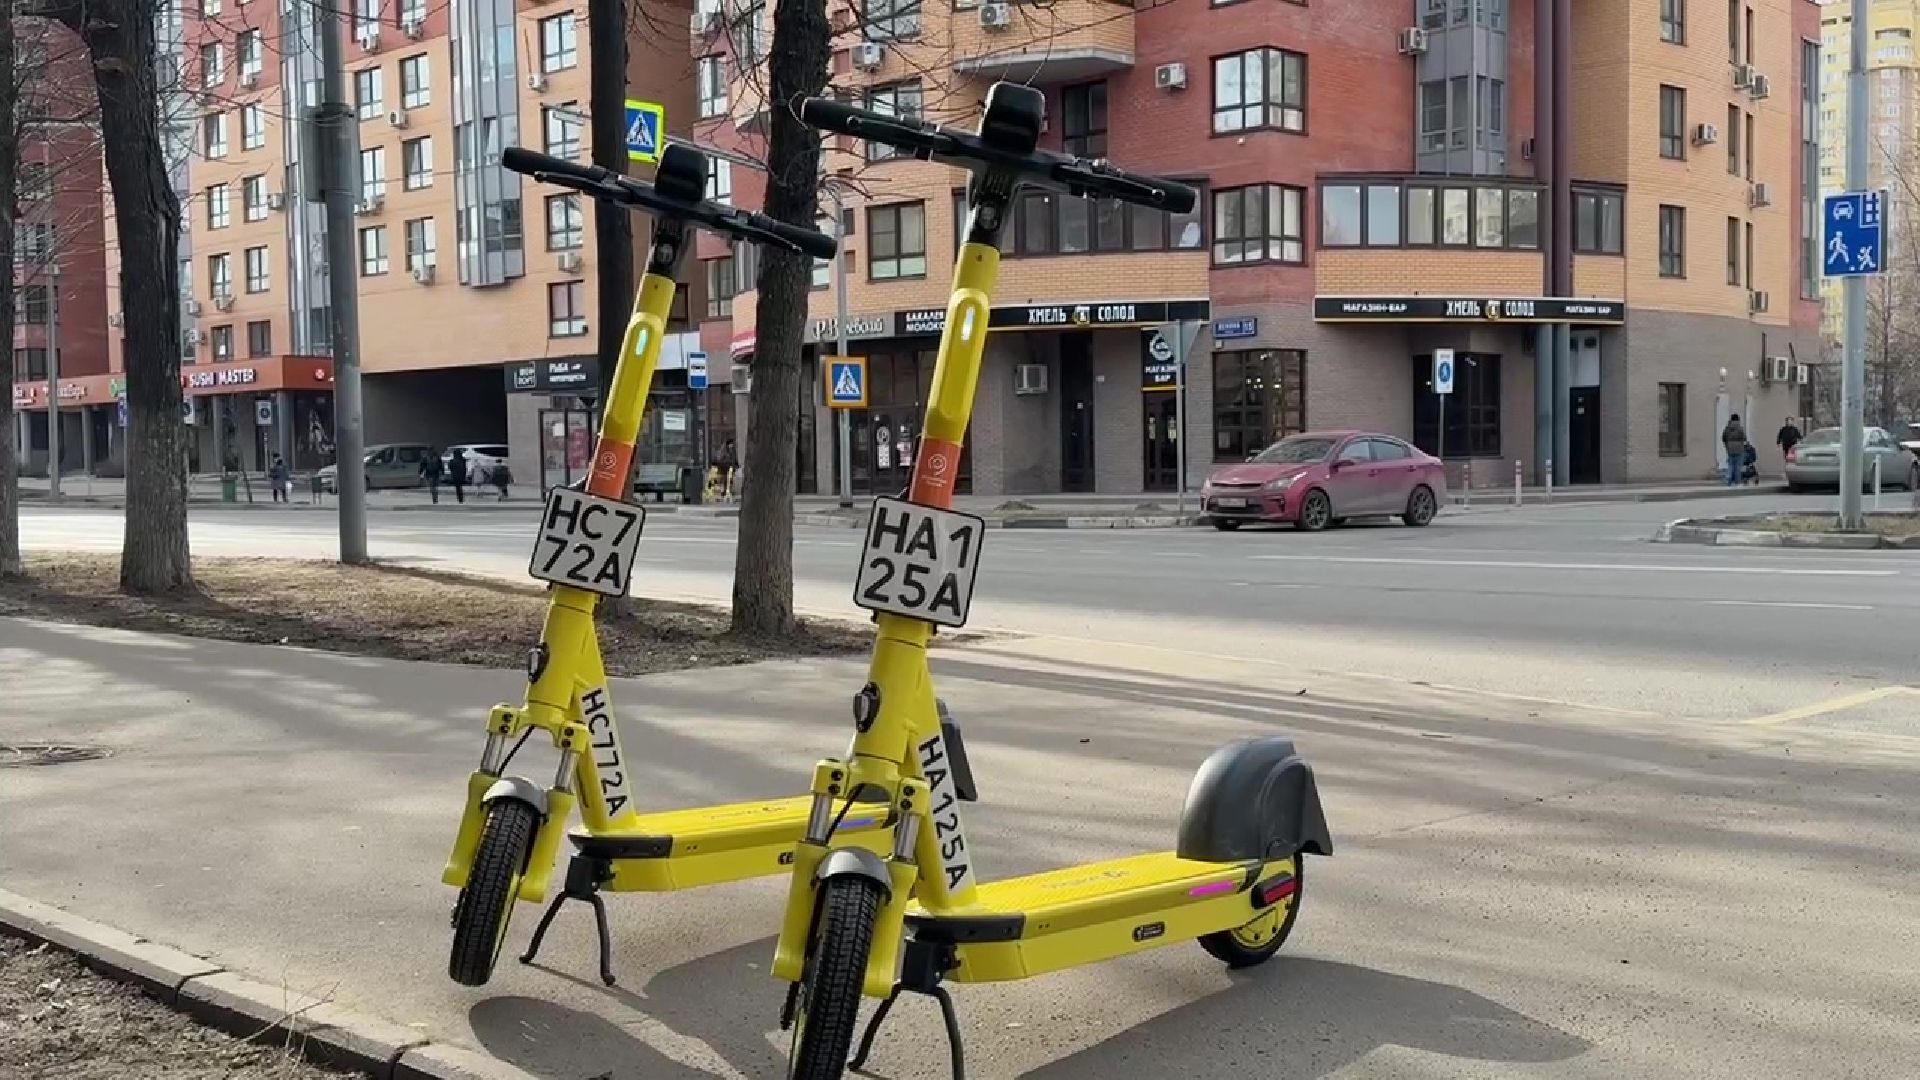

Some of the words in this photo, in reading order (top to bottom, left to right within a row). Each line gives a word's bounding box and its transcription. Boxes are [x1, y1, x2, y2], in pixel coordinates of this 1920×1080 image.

[1028, 308, 1066, 323] ХМЕЛЬ
[1098, 305, 1135, 321] СОЛОД
[1446, 300, 1480, 316] ХМЕЛЬ
[1505, 301, 1534, 316] СОЛОД
[189, 372, 214, 388] SUSHI
[219, 368, 254, 385] MASTER
[547, 495, 637, 547] НС7
[871, 507, 973, 568] НА1
[543, 535, 621, 589] 72А
[863, 557, 961, 617] 25А
[582, 688, 627, 816] НС772А
[918, 735, 967, 889] НА125А
